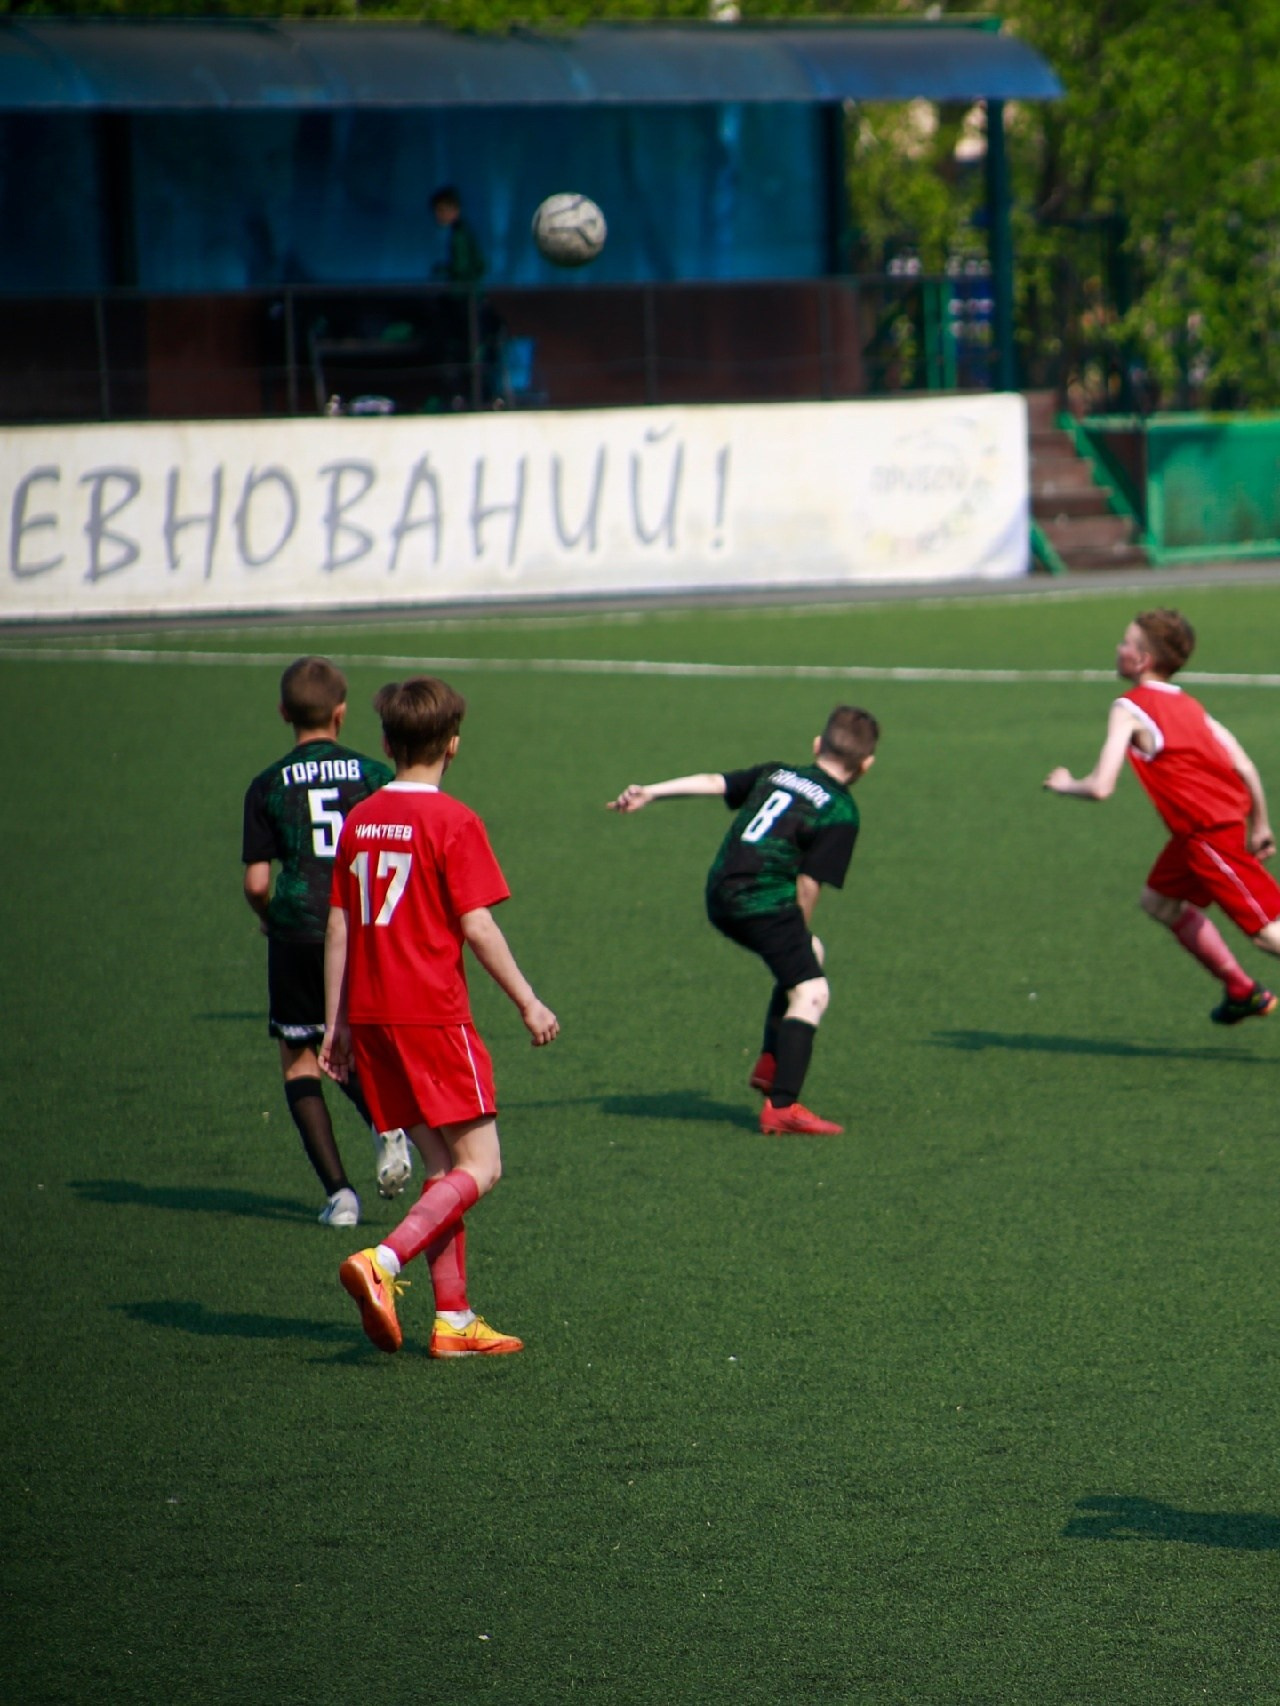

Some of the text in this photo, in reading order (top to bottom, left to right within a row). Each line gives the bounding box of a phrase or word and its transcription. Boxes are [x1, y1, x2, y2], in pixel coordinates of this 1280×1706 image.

[282, 759, 362, 786] ГОРЛОВ
[308, 787, 345, 858] 5
[741, 790, 792, 842] 8
[350, 851, 413, 927] 17
